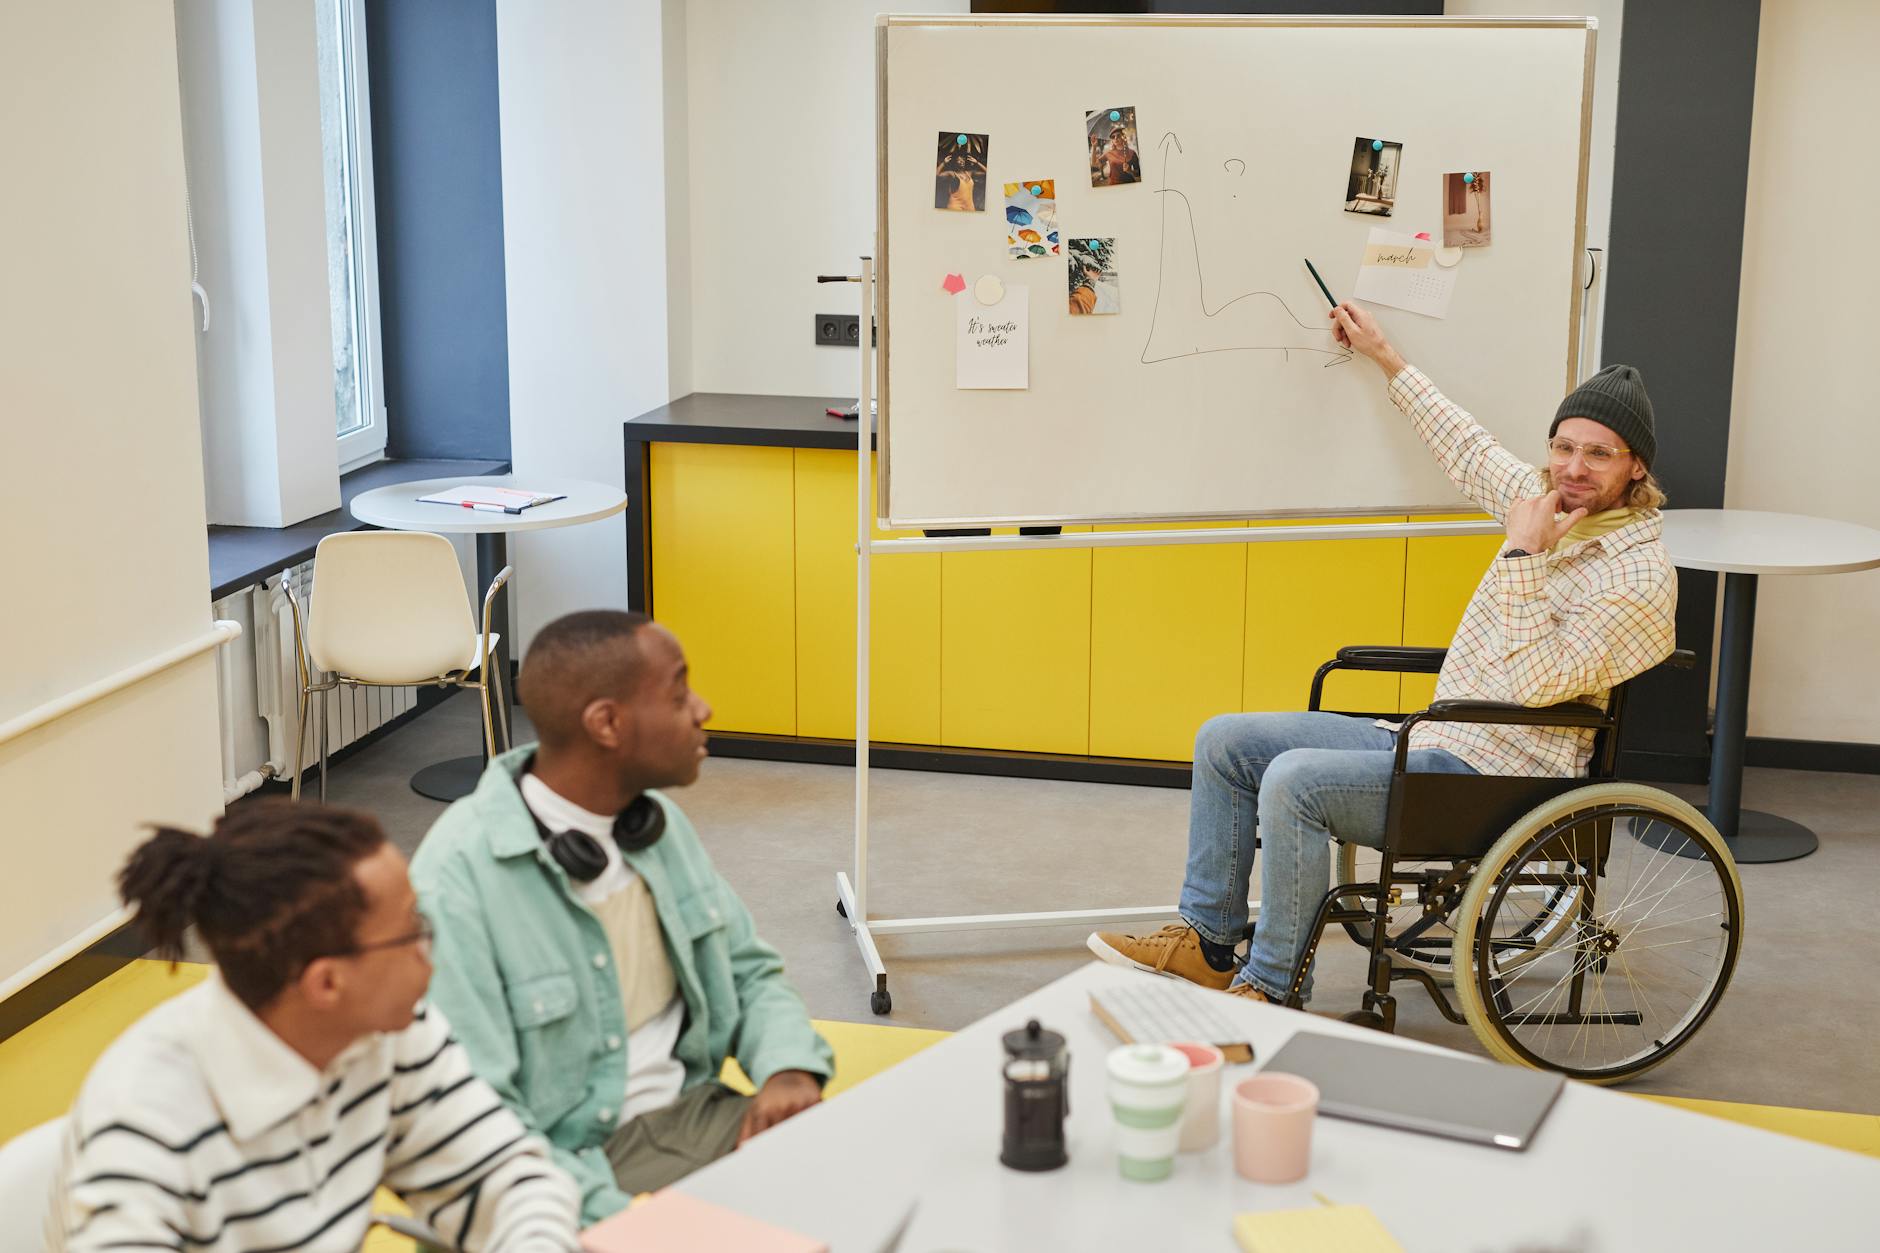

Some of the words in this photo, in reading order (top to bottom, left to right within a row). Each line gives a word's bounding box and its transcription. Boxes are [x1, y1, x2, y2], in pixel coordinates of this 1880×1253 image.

[1376, 247, 1416, 264] march
[968, 316, 984, 334] It's
[988, 320, 1016, 334] sweater
[976, 334, 1008, 347] weather
